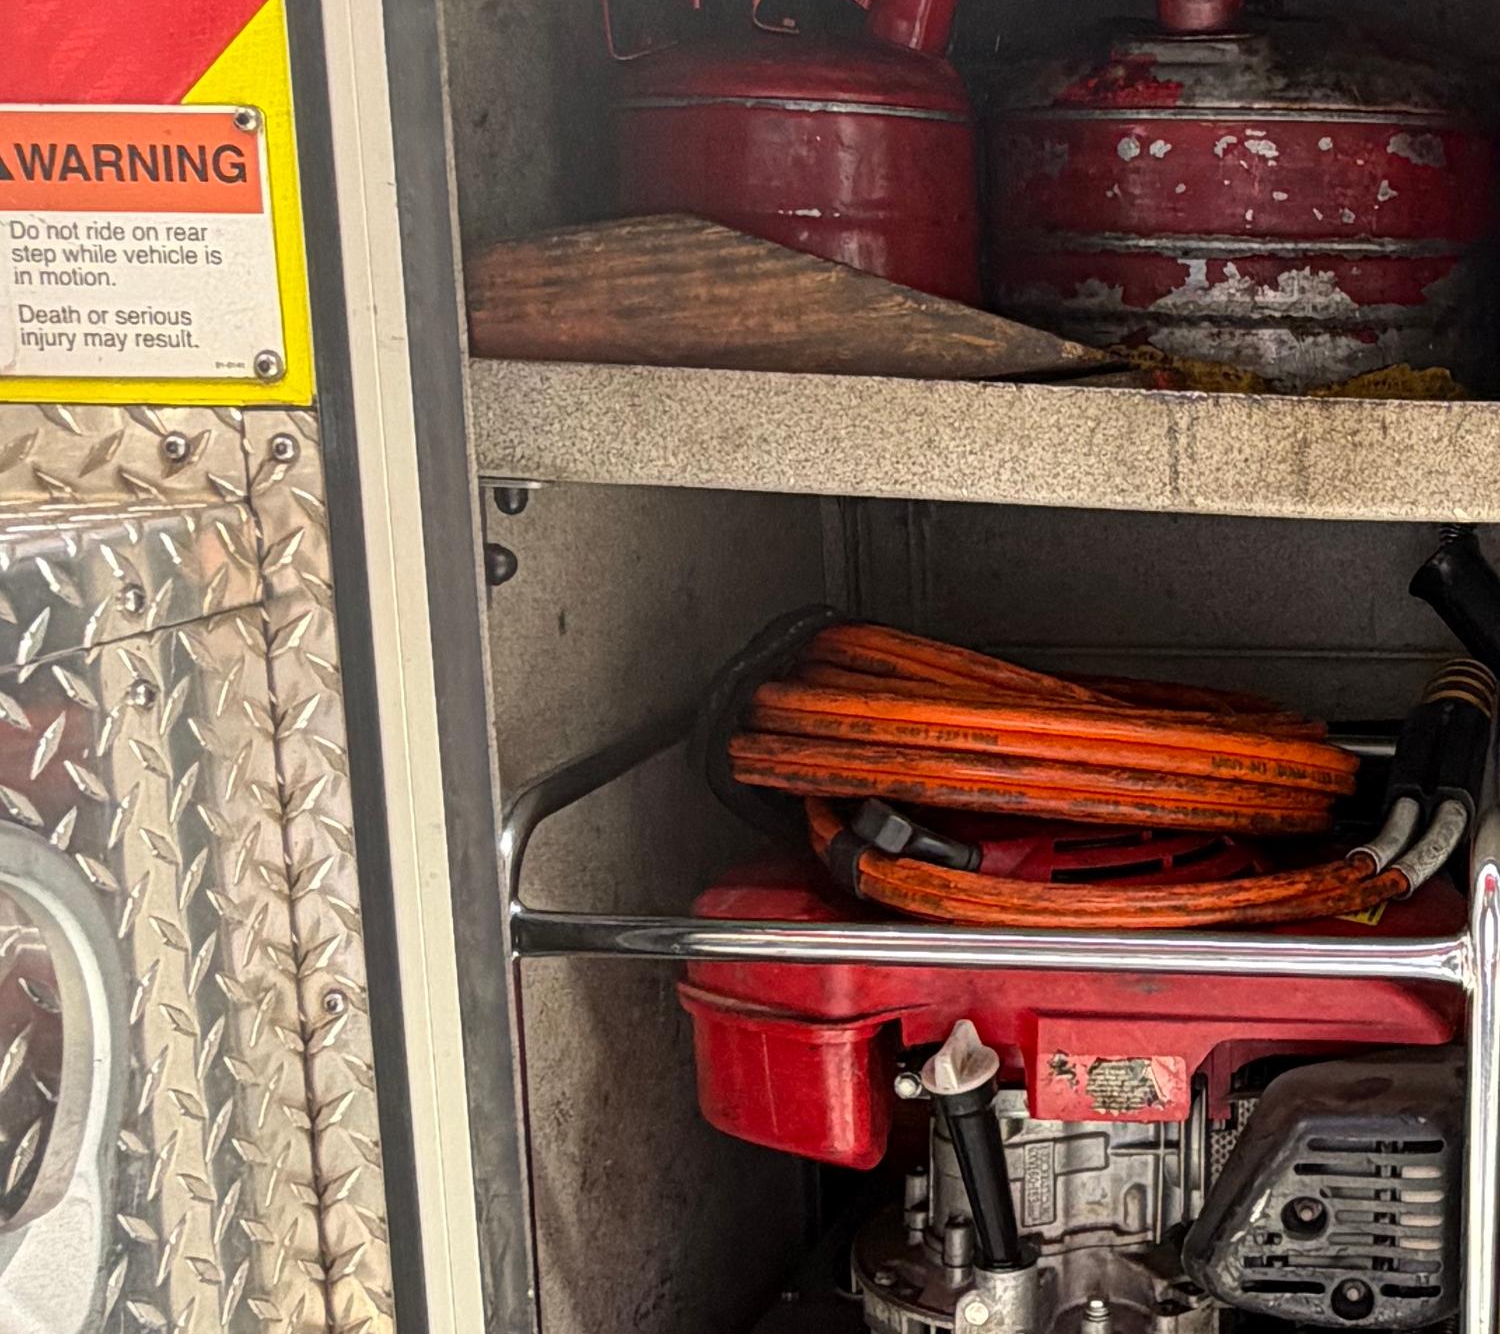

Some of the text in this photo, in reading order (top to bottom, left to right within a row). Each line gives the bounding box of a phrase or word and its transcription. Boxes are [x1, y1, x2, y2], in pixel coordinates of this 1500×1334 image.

[14, 143, 247, 183] WARNING
[10, 220, 207, 242] Do not ride on rear
[12, 244, 223, 267] step while vehicle is
[14, 269, 117, 287] in motion.
[18, 304, 193, 326] Death or serious
[20, 328, 200, 352] injury may result.
